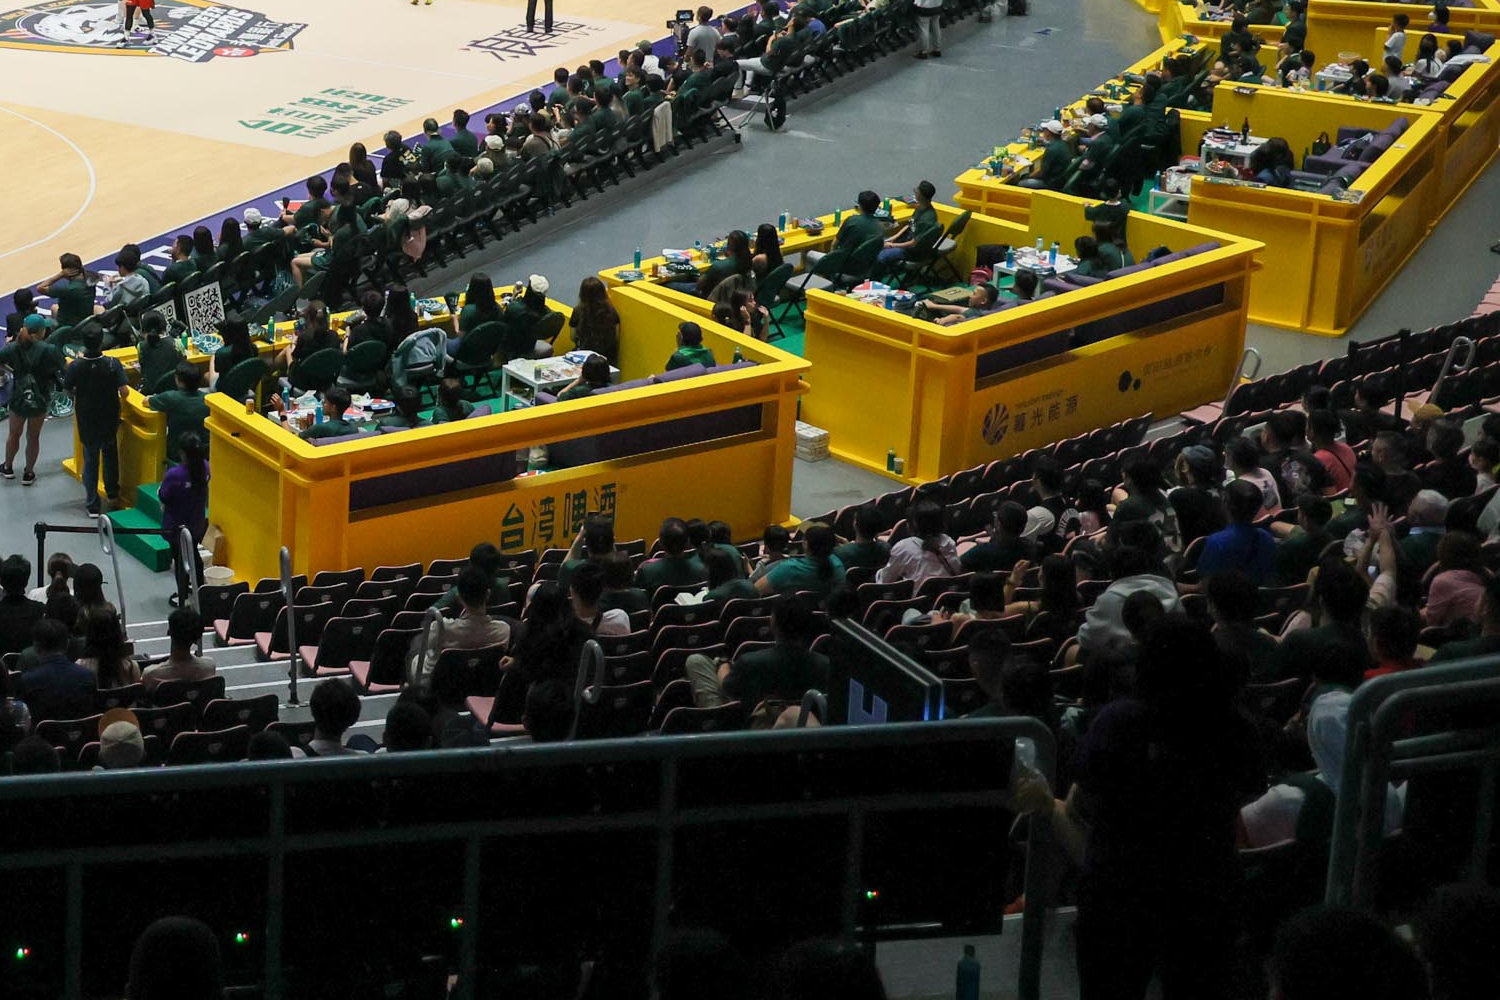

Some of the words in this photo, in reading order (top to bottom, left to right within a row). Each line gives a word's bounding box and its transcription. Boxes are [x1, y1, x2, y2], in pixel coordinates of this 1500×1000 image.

[148, 24, 201, 56] TAIWAN
[188, 6, 228, 28] BEER
[293, 115, 367, 139] TAIWAN
[358, 97, 415, 116] BEER
